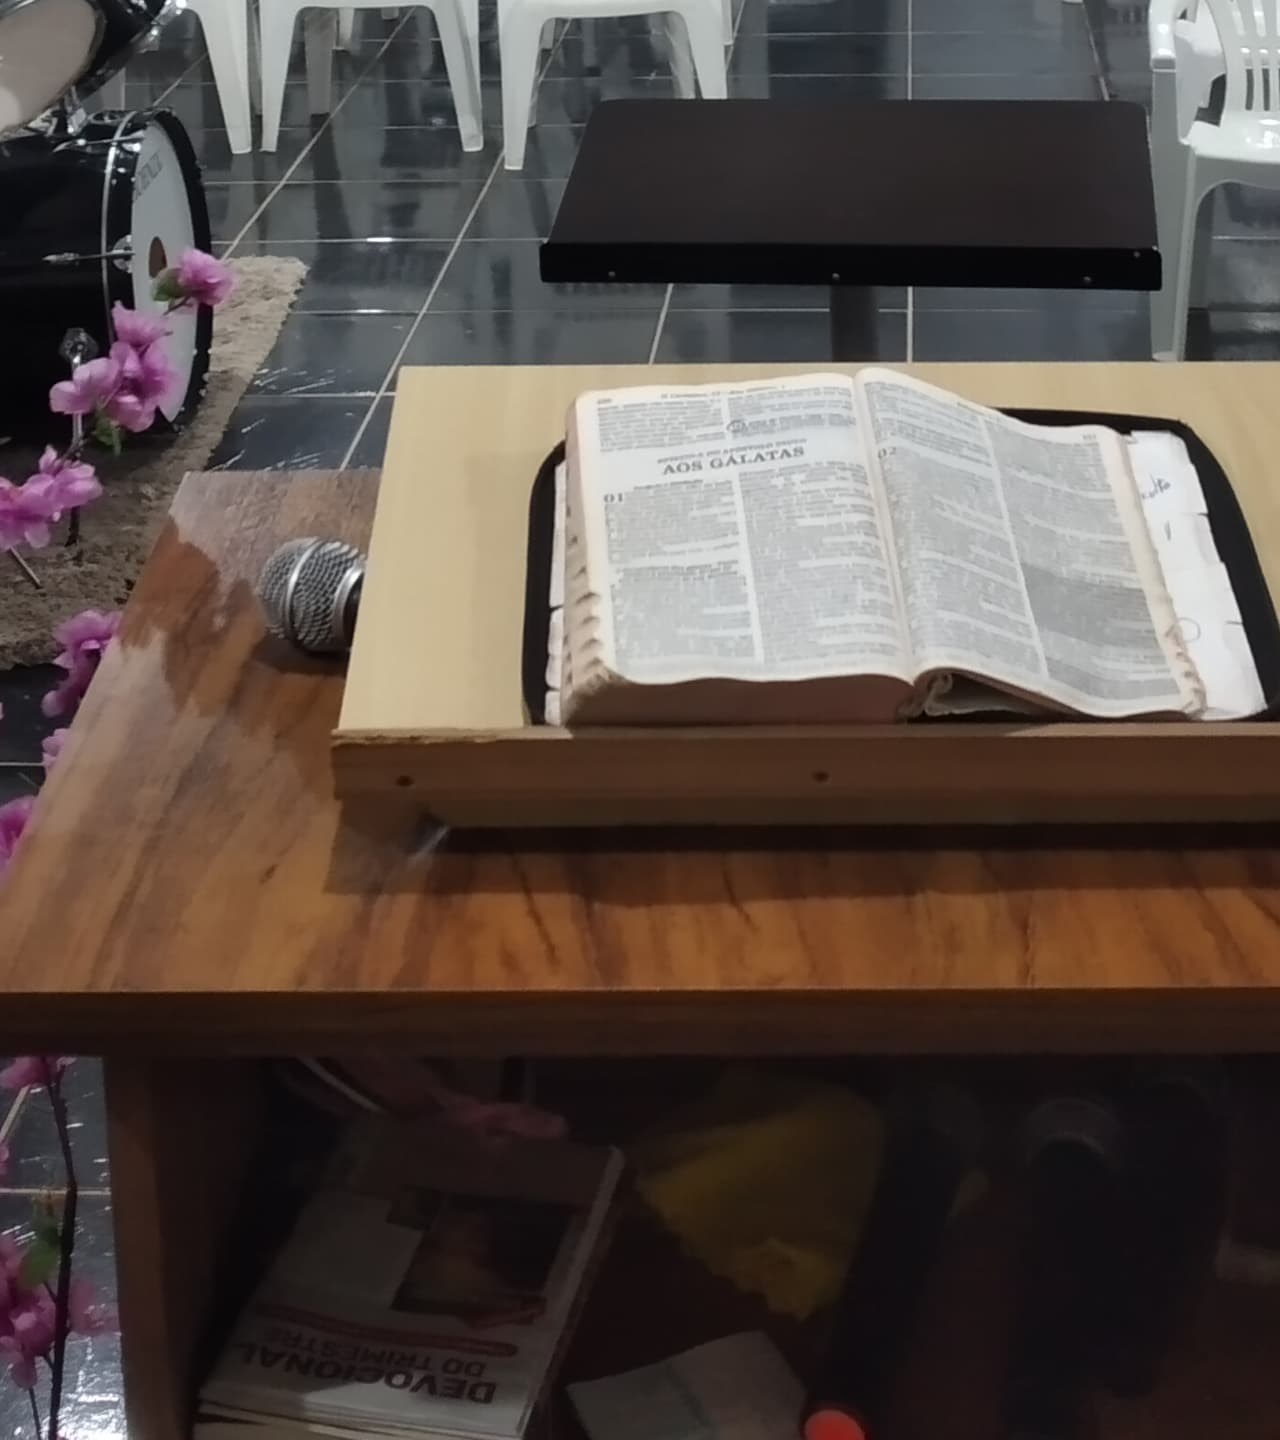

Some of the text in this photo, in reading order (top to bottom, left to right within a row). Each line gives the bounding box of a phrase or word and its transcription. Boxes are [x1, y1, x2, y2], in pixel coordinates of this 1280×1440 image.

[663, 460, 703, 475] AOS
[710, 446, 805, 469] GÁLATAS
[240, 1343, 497, 1404] DEVOCIONAL
[269, 1326, 488, 1377] DO TRIMESTRE
